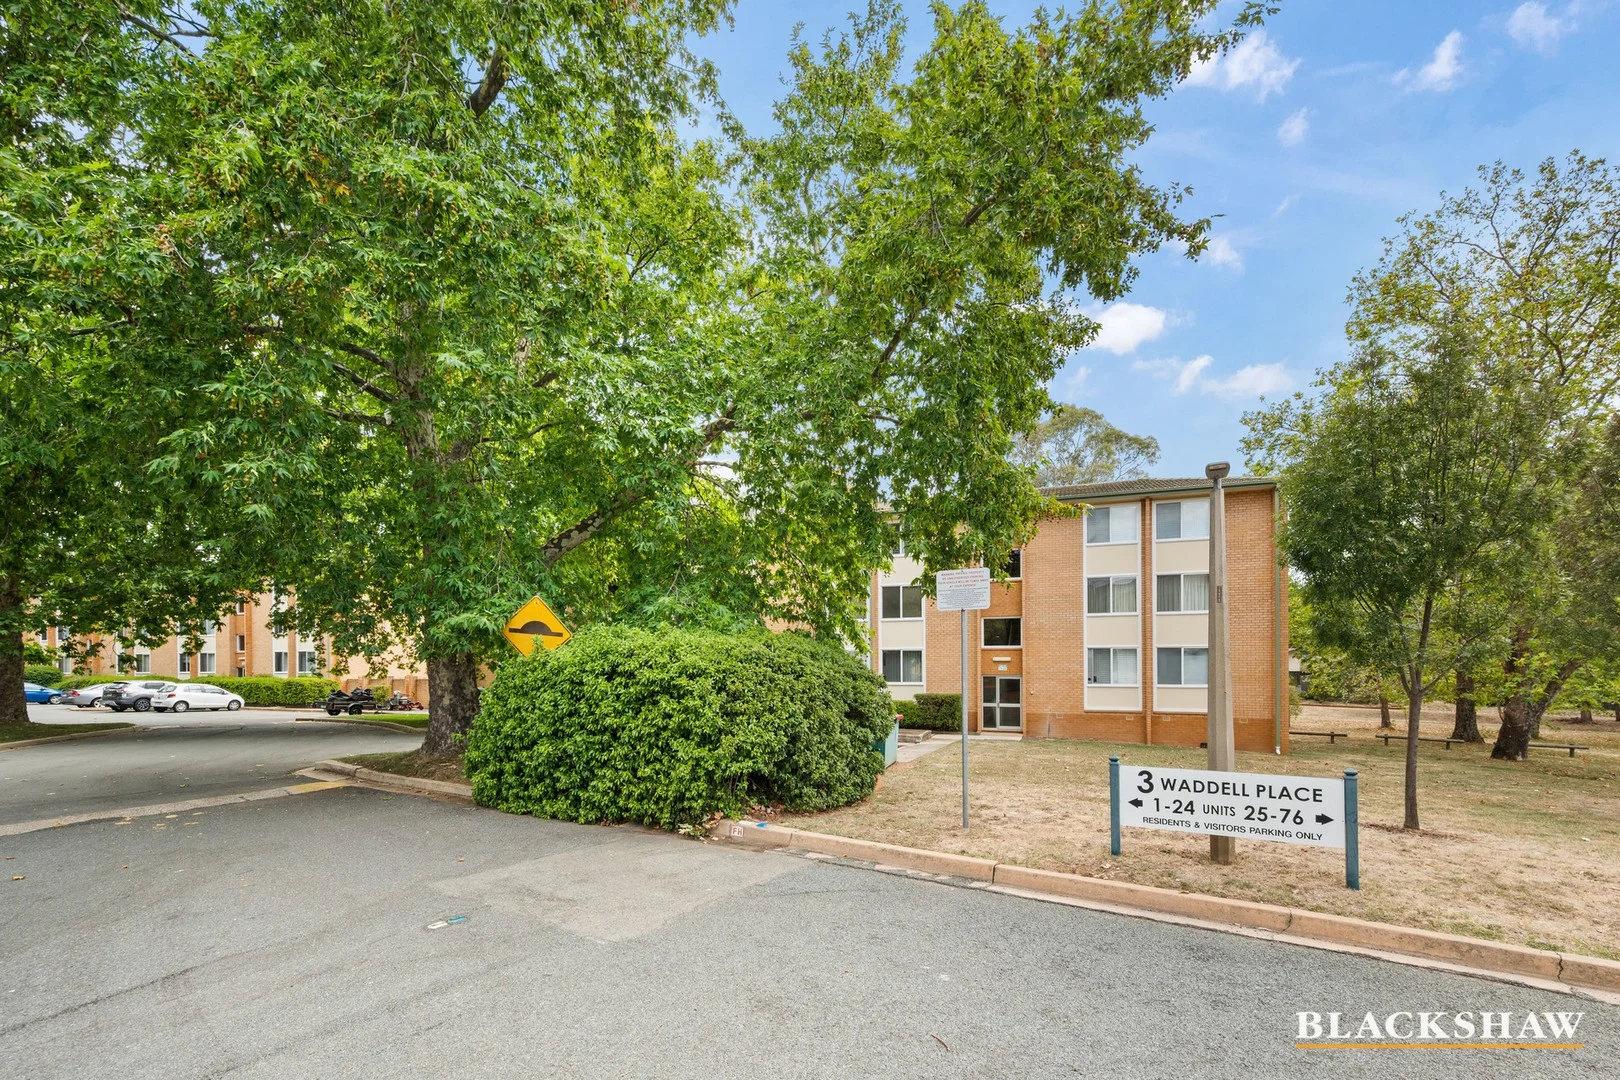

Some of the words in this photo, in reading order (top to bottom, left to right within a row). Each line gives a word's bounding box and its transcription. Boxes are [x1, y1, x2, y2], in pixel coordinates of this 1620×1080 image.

[1136, 769, 1155, 794] 3
[1160, 777, 1250, 797] WADDELL
[1256, 784, 1323, 802] PLACE
[1153, 798, 1195, 815] 1-24
[1202, 804, 1236, 817] UNITS
[1243, 805, 1304, 826] 25-76
[732, 827, 742, 836] FH
[1142, 816, 1191, 828] RESIDENTS
[1194, 821, 1201, 829] &
[1203, 822, 1247, 834] VISITORS
[1249, 826, 1292, 838] PARKING
[1295, 831, 1323, 841] ONLY
